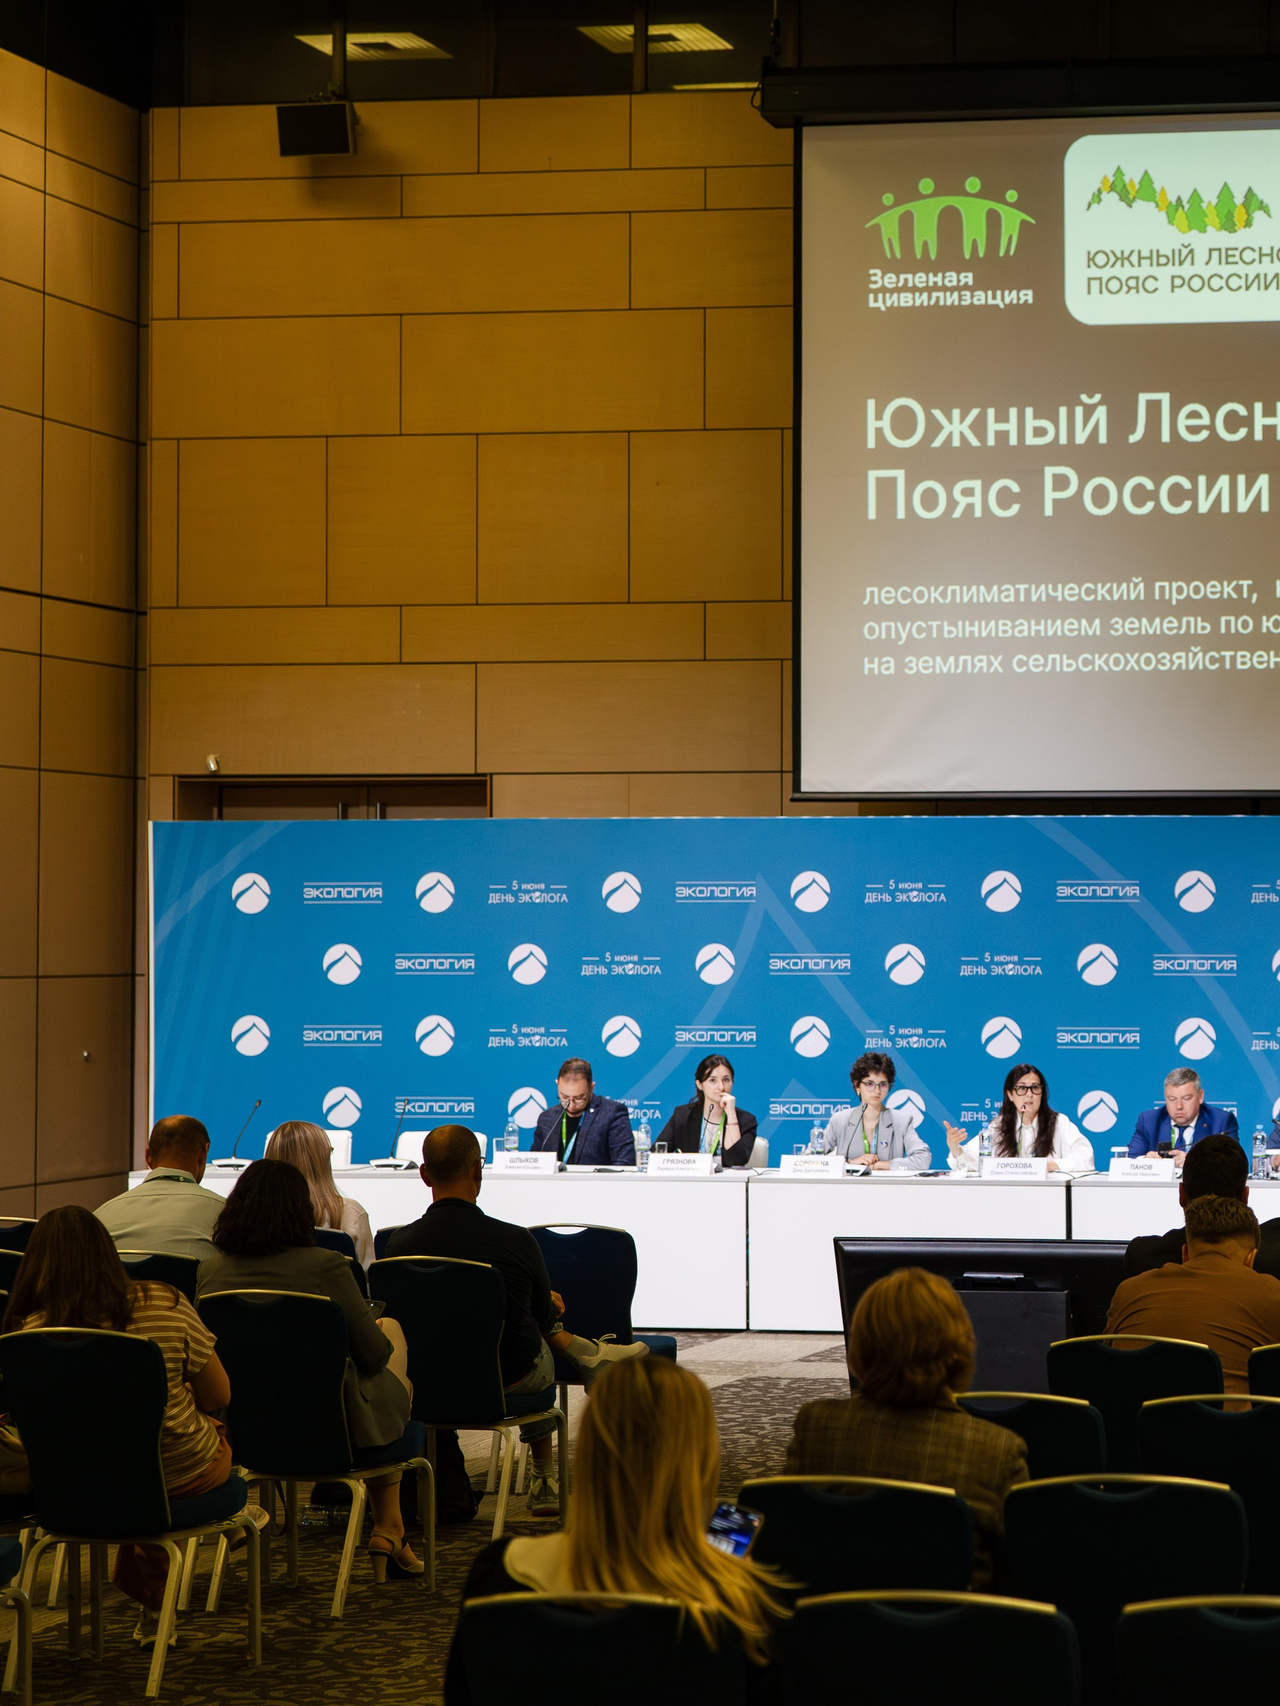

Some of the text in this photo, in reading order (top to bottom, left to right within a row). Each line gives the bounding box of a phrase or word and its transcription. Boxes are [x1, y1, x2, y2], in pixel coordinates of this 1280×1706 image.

[1087, 243, 1194, 269] ЮЖНЫЙ
[869, 269, 973, 289] Зеленая
[1087, 273, 1279, 295] ПОЯС РОССИИ
[869, 290, 1033, 311] цивилизация
[867, 394, 1107, 448] Южный
[868, 466, 1269, 519] Пояс России
[863, 578, 1144, 605] лесоклиматический
[1155, 580, 1257, 605] проект,
[864, 619, 1100, 645] опустыниванием
[1110, 617, 1210, 636] земель
[1221, 615, 1253, 634] по
[864, 657, 894, 674] на
[905, 655, 1003, 674] землях
[512, 880, 518, 890] 5
[889, 880, 895, 889] 5
[304, 888, 382, 898] ЭКОЛОГИЯ
[676, 887, 756, 897] ЭКОЛОГИЯ
[1056, 885, 1141, 898] ЭКОЛОГИЯ
[488, 893, 515, 904] ДЕНЬ
[865, 893, 892, 903] ДЕНЬ
[1251, 893, 1279, 903] ДЕНЬ
[605, 952, 611, 962] 5
[985, 952, 990, 962] 5
[396, 959, 474, 969] ЭКОЛОГИЯ
[770, 959, 850, 971] ЭКОЛОГИЯ
[1153, 958, 1237, 971] ЭКОЛОГИЯ
[581, 965, 608, 976] ДЕНЬ
[960, 965, 987, 976] ДЕНЬ
[512, 1024, 518, 1034] 5
[889, 1025, 895, 1035] 5
[303, 1031, 382, 1040] ЭКОЛОГИЯ
[676, 1031, 756, 1044] ЭКОЛОГИЯ
[1056, 1031, 1141, 1044] ЭКОЛОГИЯ
[488, 1037, 515, 1047] ДЕНЬ
[865, 1038, 892, 1048] ДЕНЬ
[1251, 1040, 1279, 1051] ДЕНЬ
[984, 1098, 992, 1109] 5
[960, 1110, 988, 1122] ДЕНЬ
